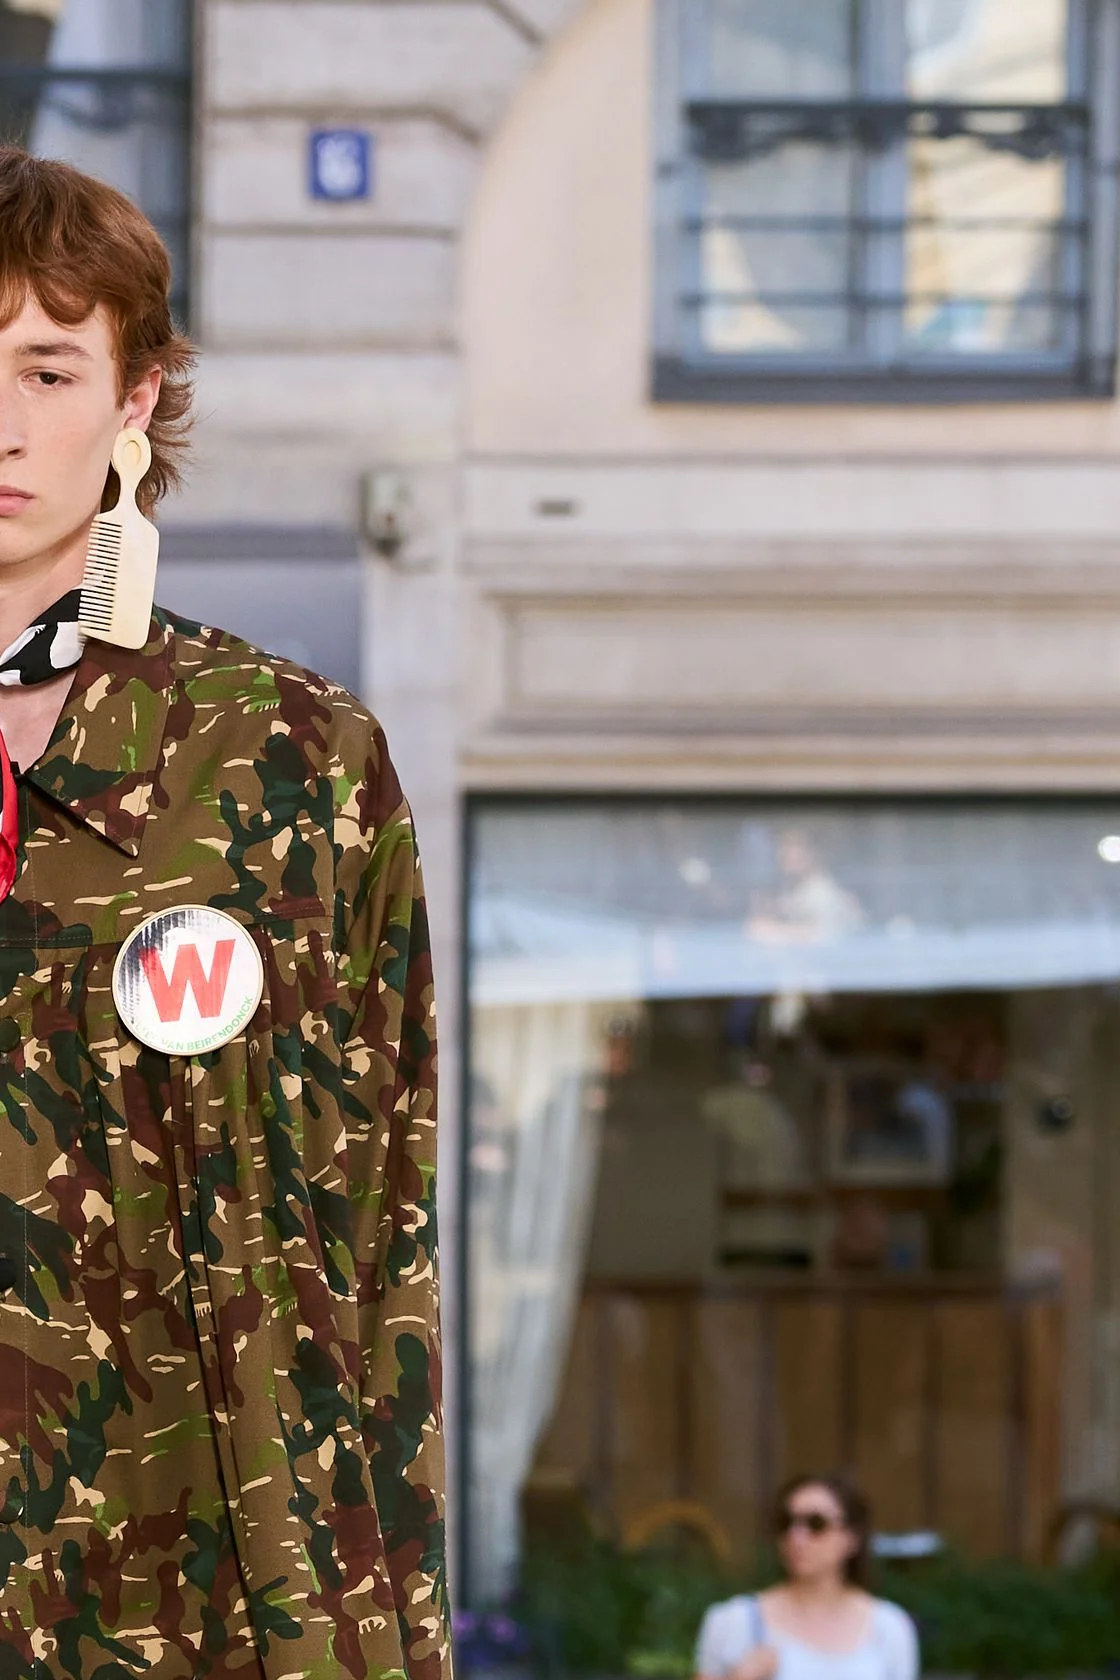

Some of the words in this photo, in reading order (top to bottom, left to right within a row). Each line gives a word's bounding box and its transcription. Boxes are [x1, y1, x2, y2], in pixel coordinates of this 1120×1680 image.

[138, 938, 236, 1023] W
[161, 1038, 184, 1050] VAN
[186, 995, 254, 1051] BEIRENDONCK
